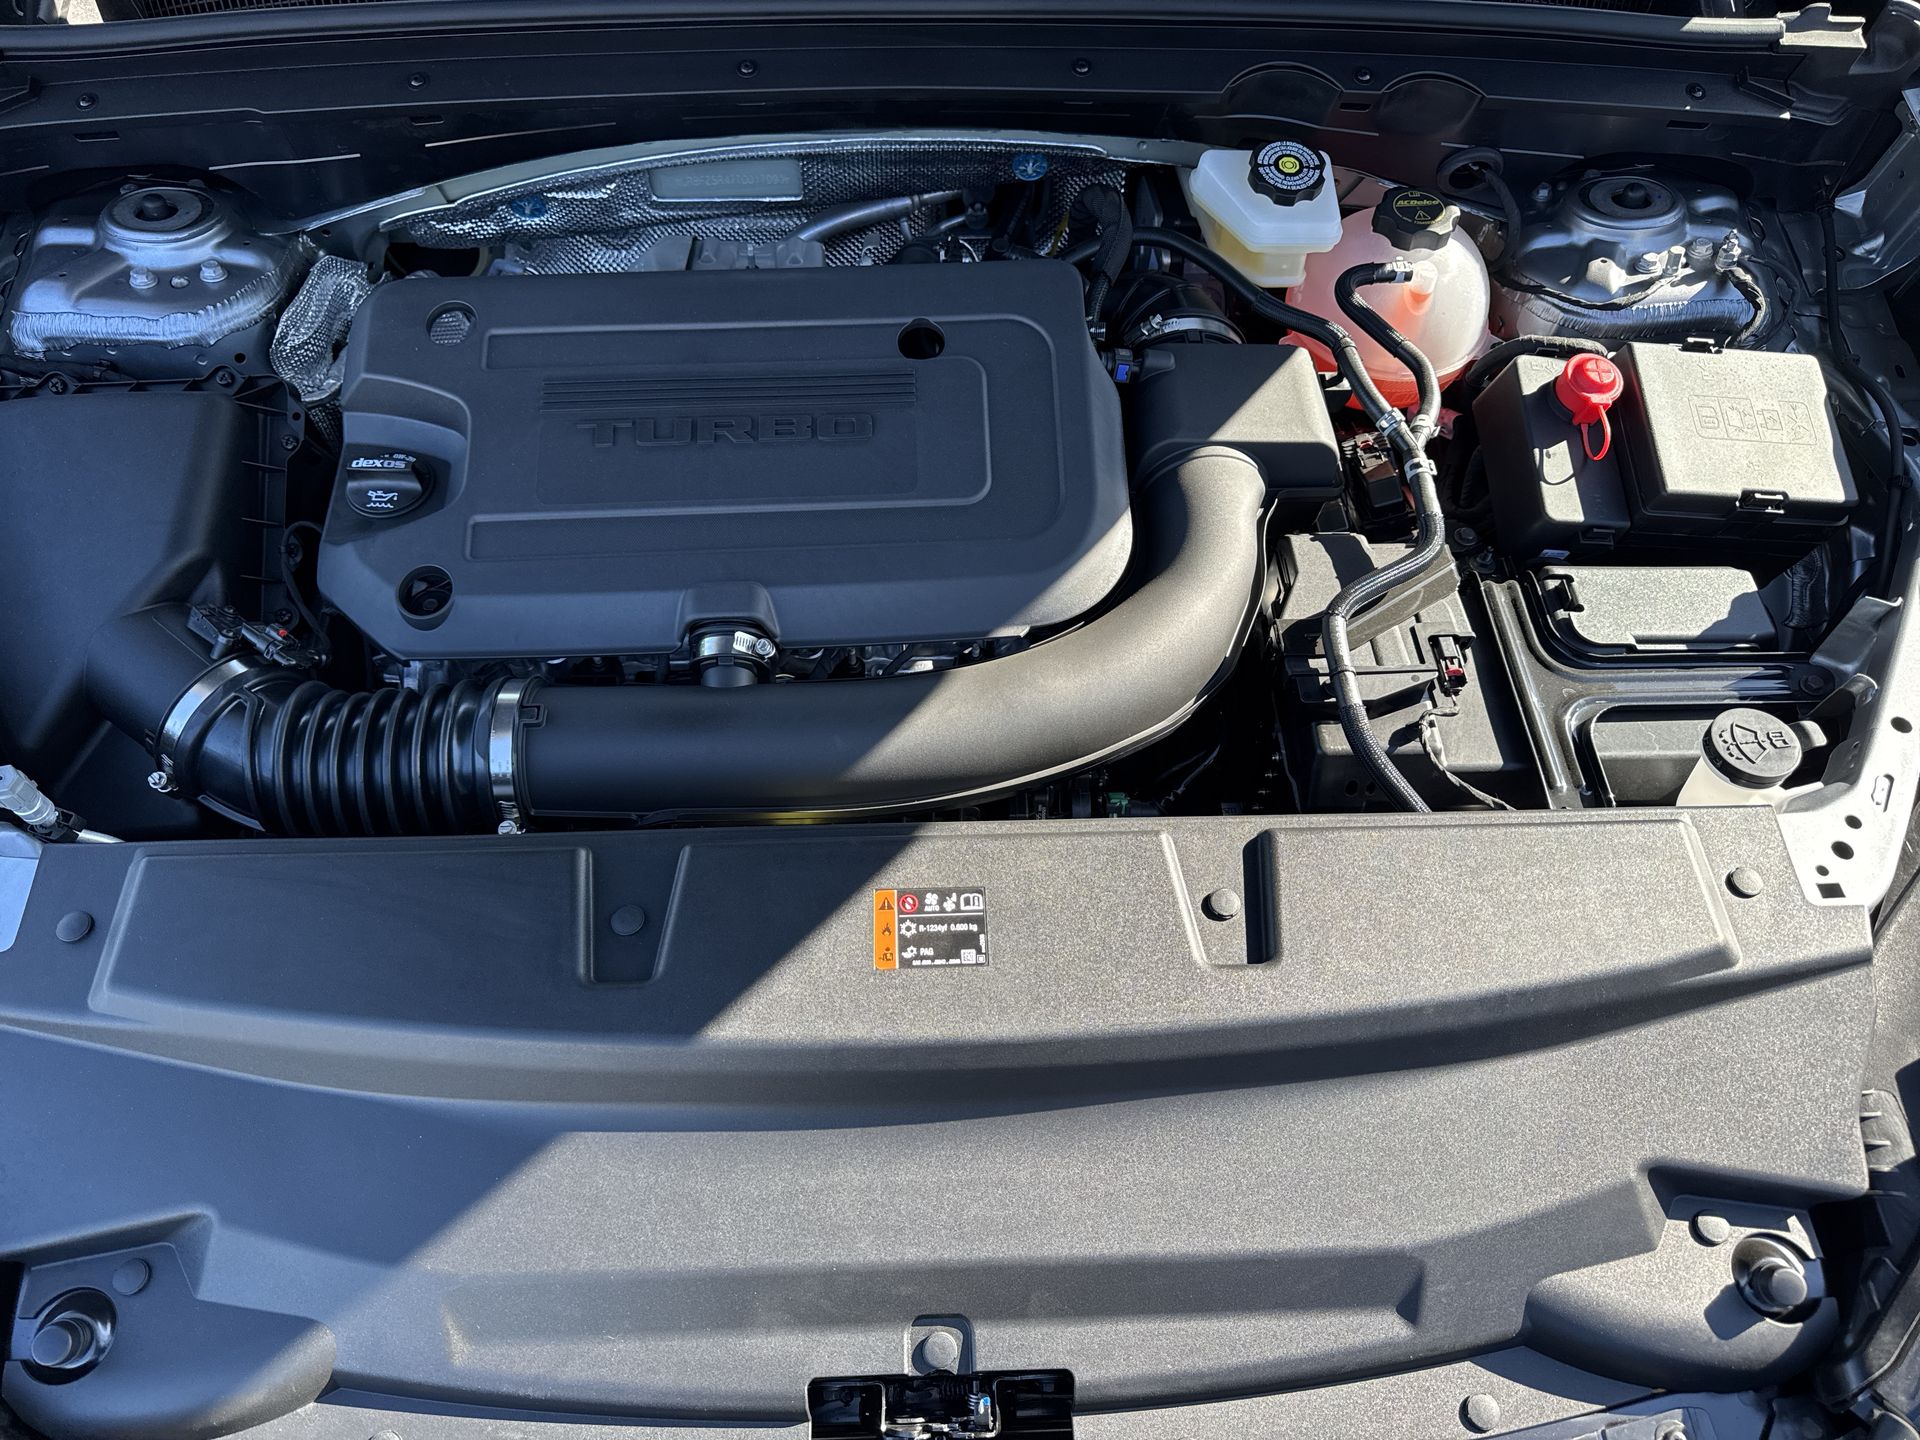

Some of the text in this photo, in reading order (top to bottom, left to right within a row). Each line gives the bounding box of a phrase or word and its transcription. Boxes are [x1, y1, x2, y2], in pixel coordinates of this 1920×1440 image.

[1396, 199, 1440, 207] ACDelco
[576, 414, 874, 448] TURBO
[351, 457, 408, 469] dexos
[918, 923, 948, 933] R-1234yf
[969, 923, 978, 932] kg
[919, 947, 934, 956] PAG
